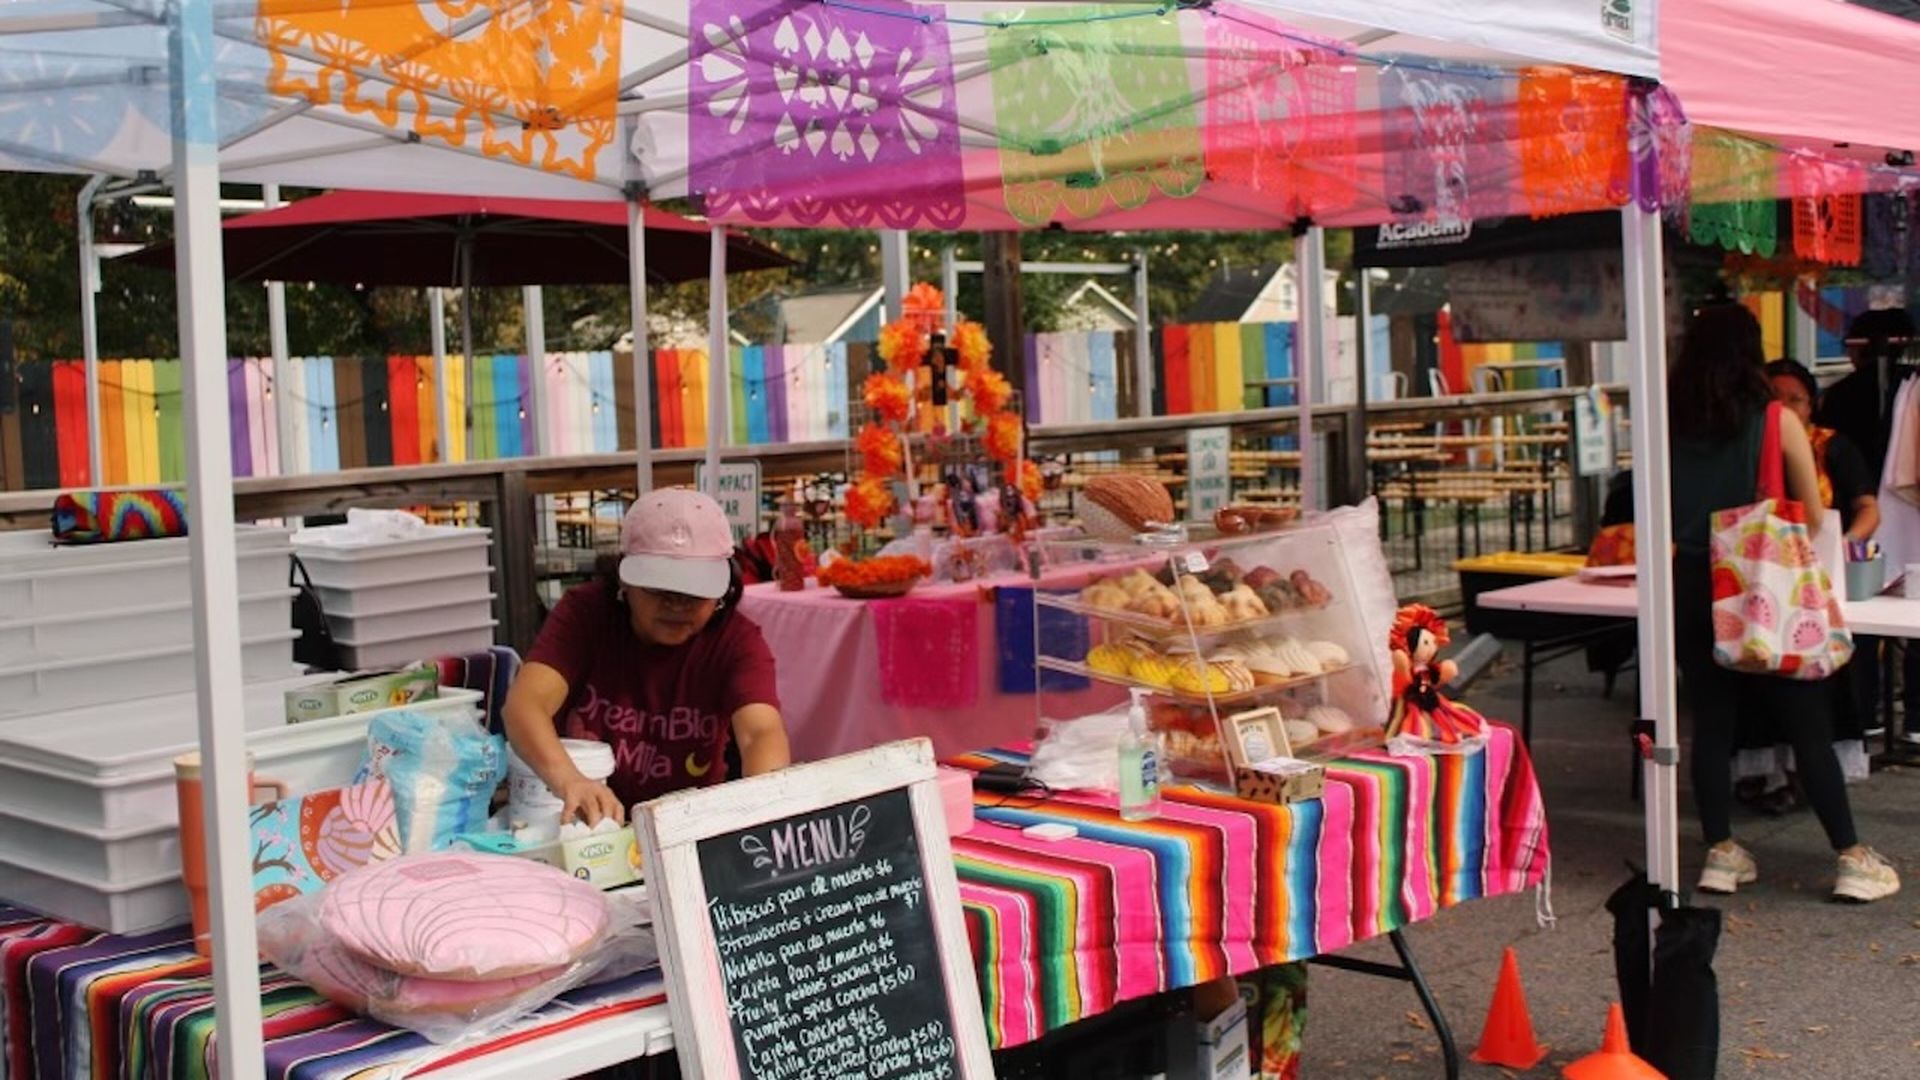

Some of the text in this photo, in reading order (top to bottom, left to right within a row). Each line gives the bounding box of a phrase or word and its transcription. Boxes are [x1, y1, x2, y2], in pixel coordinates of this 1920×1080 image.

[702, 474, 753, 492] MPACT
[771, 814, 846, 869] MENU
[713, 897, 776, 931] Hibiscus
[778, 886, 805, 914] pan
[831, 864, 875, 890] muerto
[904, 890, 919, 909] $7
[725, 951, 776, 983] Nutella
[779, 941, 806, 965] pan
[835, 939, 877, 966] muerto
[730, 997, 780, 1026] Fruity
